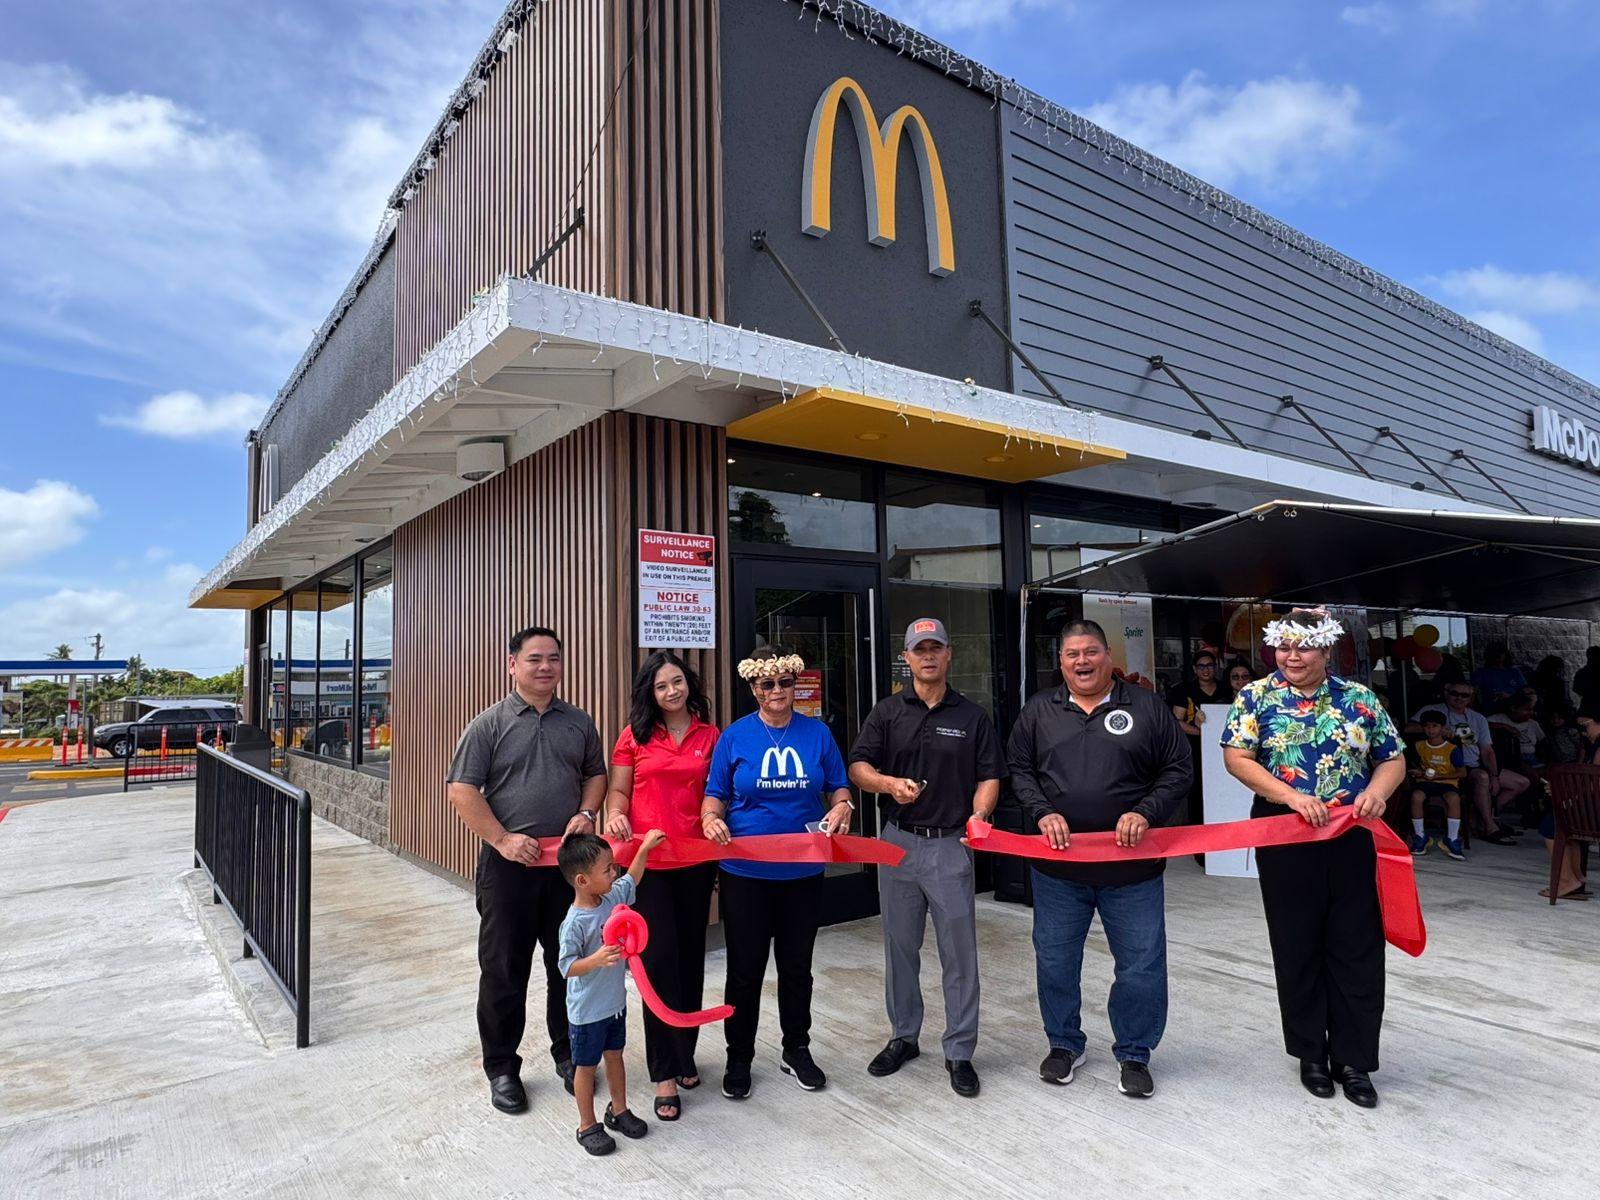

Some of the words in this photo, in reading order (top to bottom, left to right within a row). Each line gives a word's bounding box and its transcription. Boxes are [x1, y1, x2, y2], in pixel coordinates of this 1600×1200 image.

[1533, 405, 1600, 468] McDo
[644, 534, 710, 549] SURVEILLANCE
[661, 549, 694, 559] NOTICE
[666, 566, 707, 574] SURVEILLANCE
[657, 592, 699, 602] NOTICE
[1124, 626, 1144, 639] Sprite
[756, 779, 771, 788] i'm
[773, 779, 799, 788] lovin'
